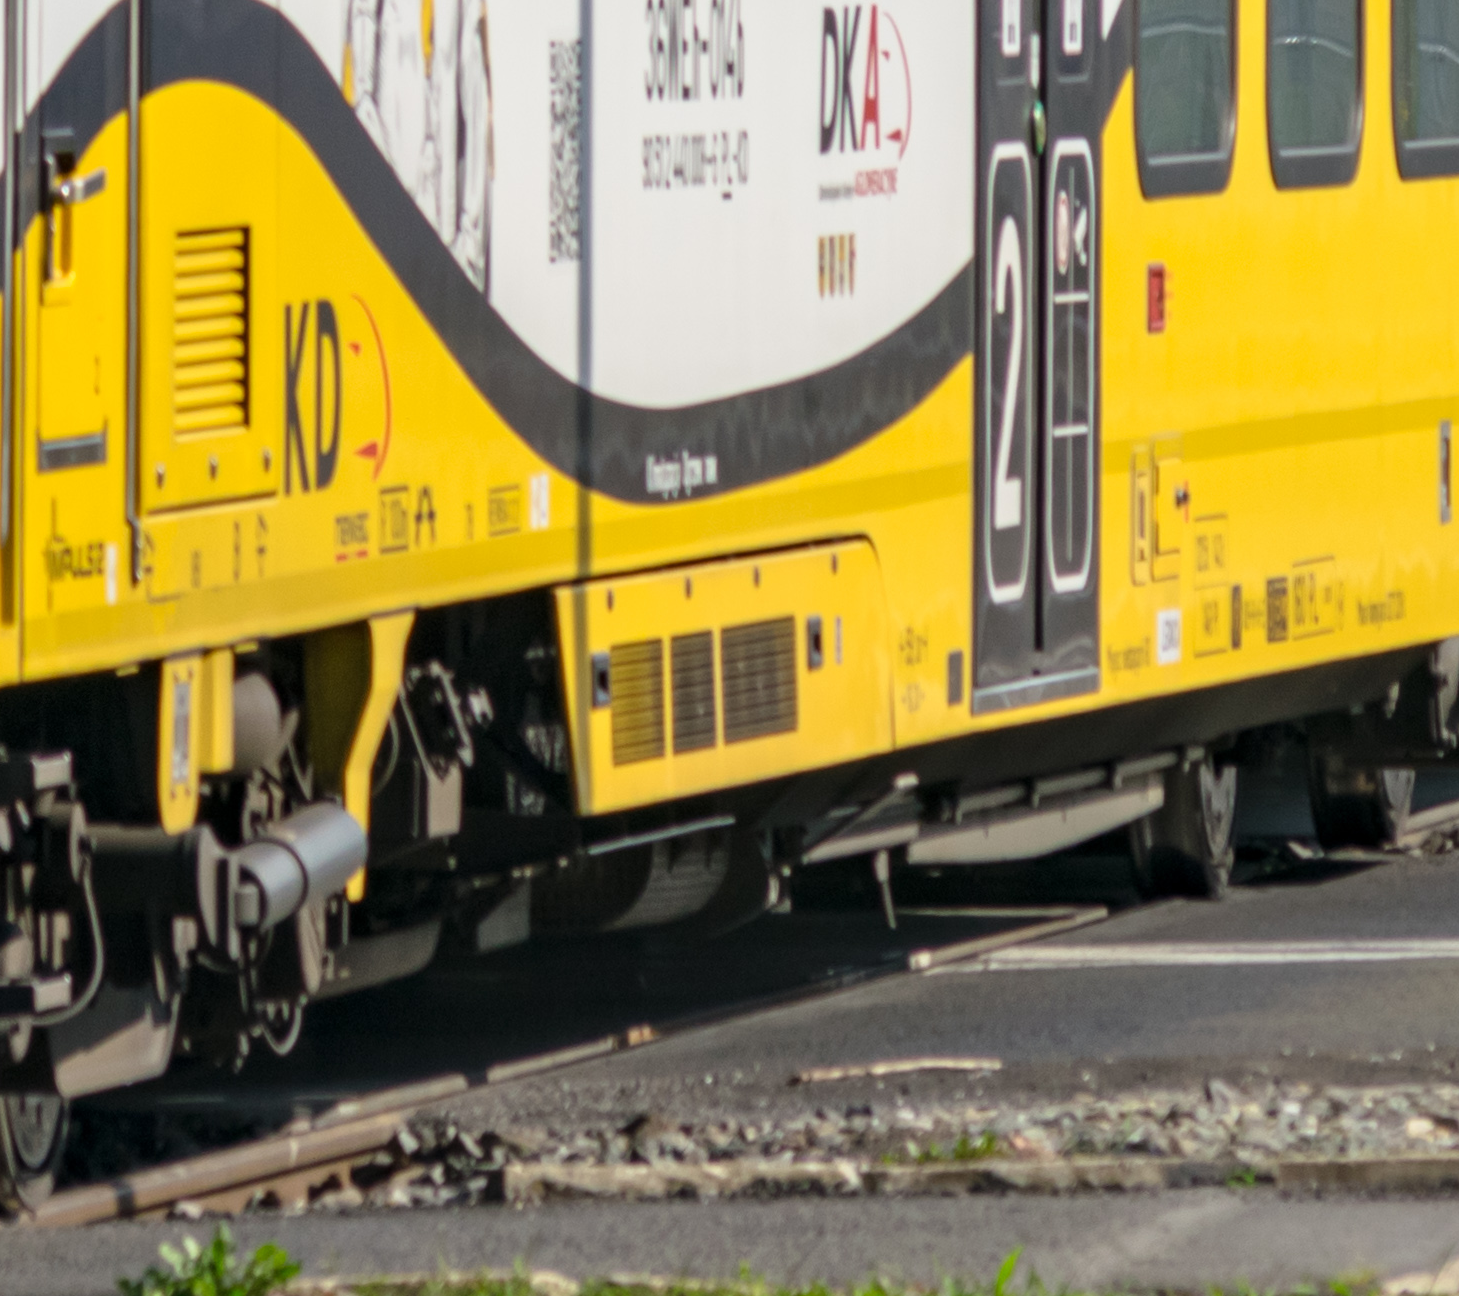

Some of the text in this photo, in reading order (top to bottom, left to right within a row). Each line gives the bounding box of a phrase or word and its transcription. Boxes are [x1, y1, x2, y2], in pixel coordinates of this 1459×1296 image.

[818, 3, 881, 155] DKA
[284, 297, 342, 497] KD
[993, 215, 1024, 531] 2
